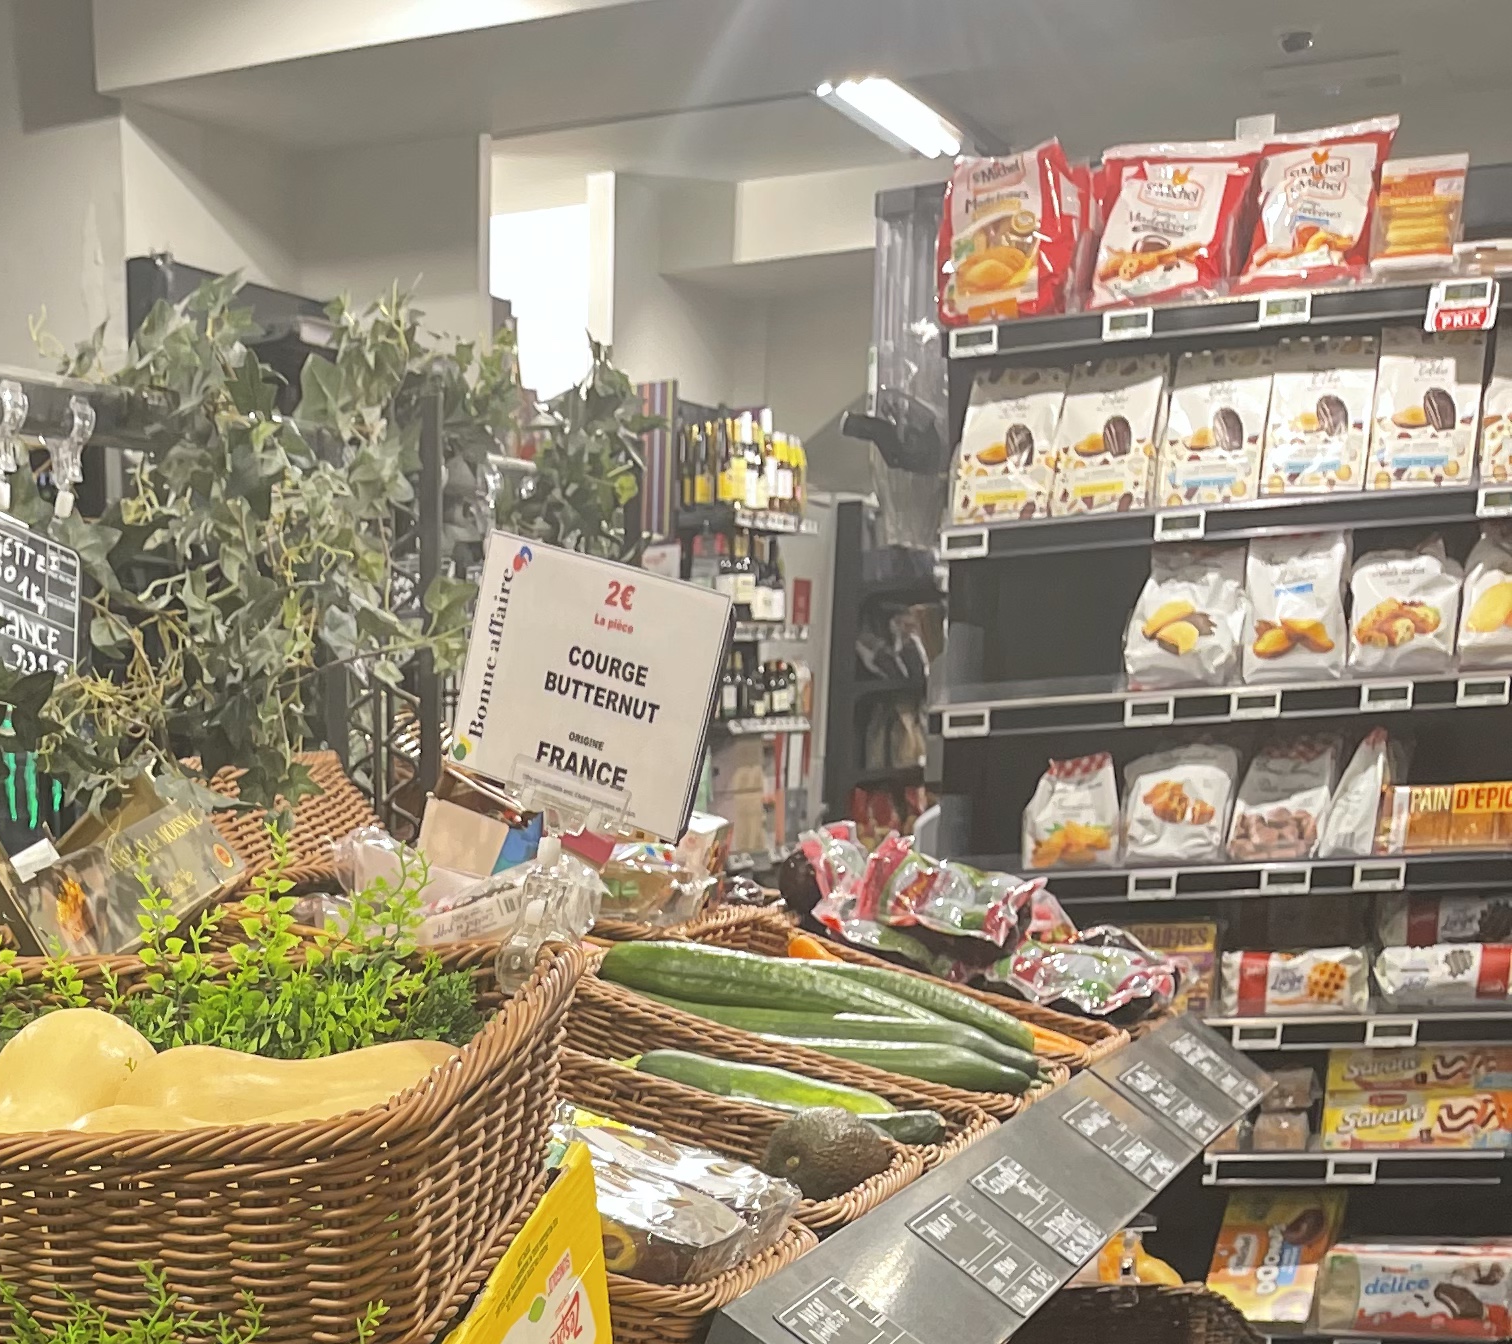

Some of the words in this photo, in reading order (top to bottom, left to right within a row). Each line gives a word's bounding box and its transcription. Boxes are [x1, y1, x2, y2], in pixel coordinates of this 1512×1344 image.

[1440, 311, 1482, 329] PRIX
[604, 580, 636, 611] 2€
[594, 613, 606, 627] La
[468, 656, 497, 738] Bonne
[488, 567, 514, 653] affaire
[568, 645, 649, 688] COURGE
[544, 670, 660, 724] BUTTERNUT
[568, 731, 605, 751] ORIGINE
[535, 740, 628, 792] FRANCE
[1410, 786, 1451, 812] PAIN
[1337, 1104, 1426, 1134] Savane
